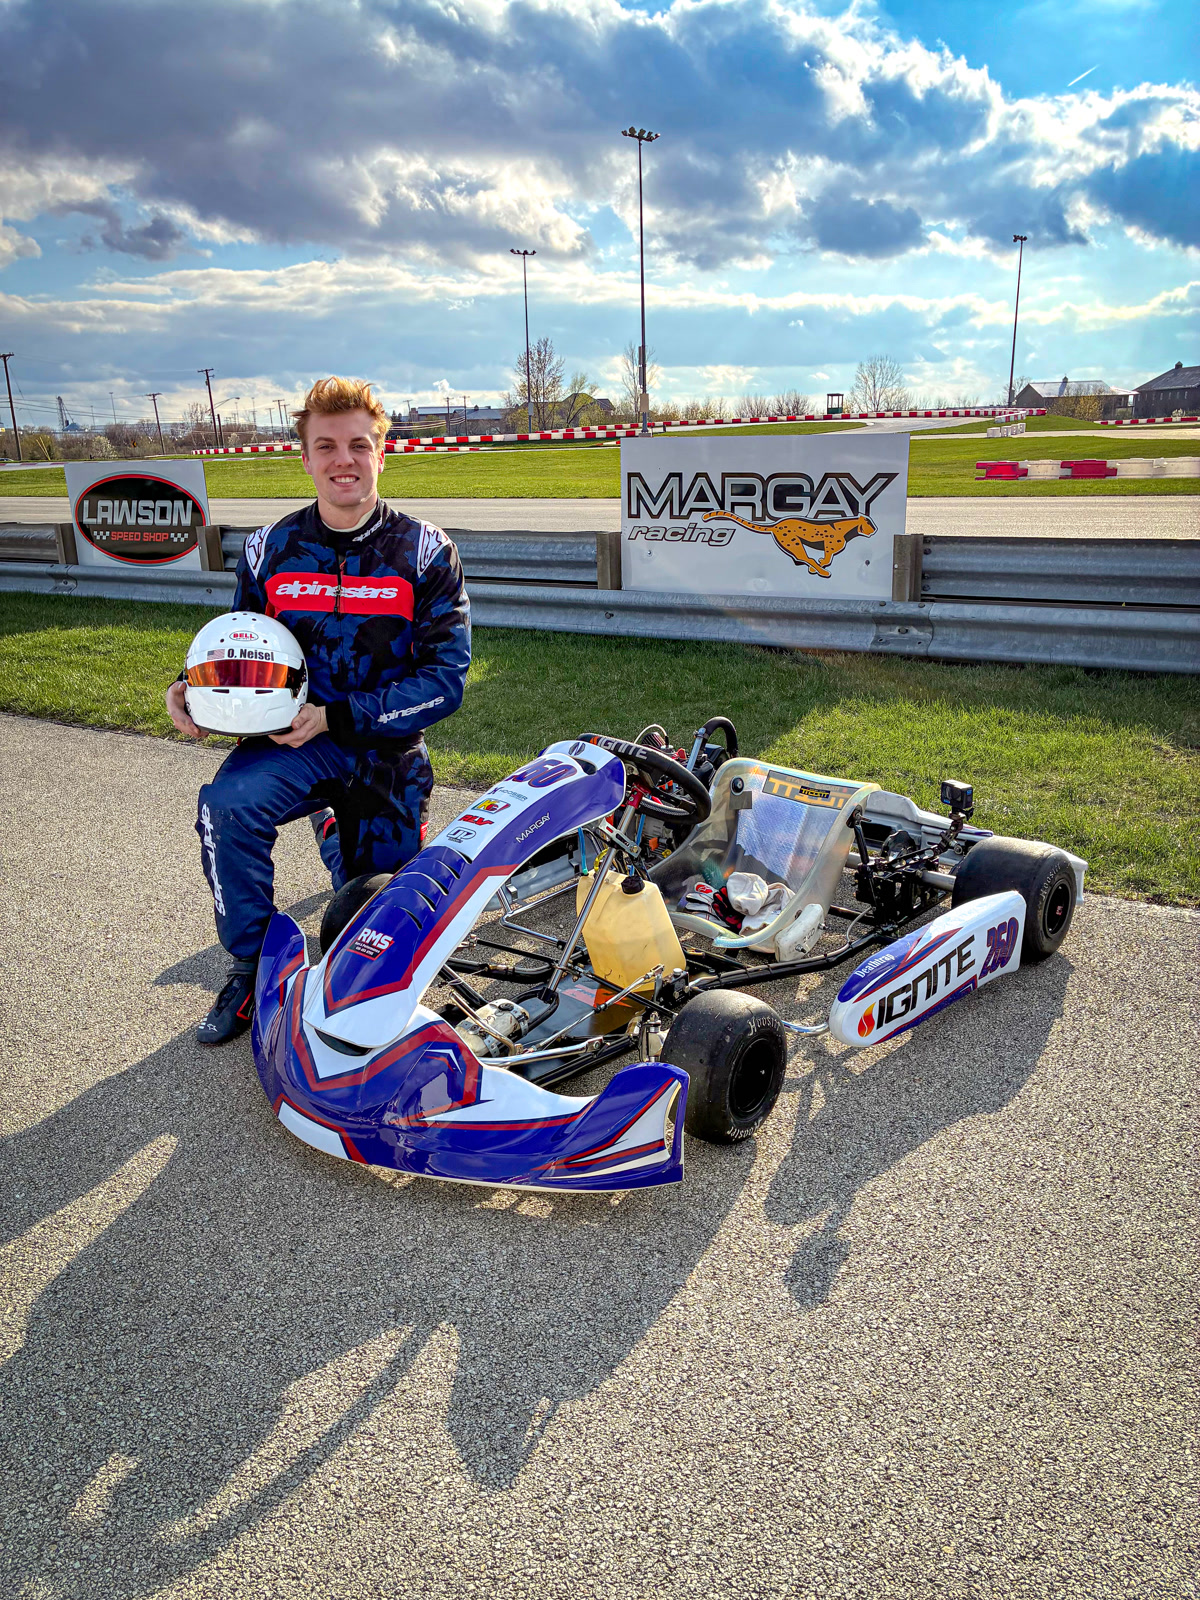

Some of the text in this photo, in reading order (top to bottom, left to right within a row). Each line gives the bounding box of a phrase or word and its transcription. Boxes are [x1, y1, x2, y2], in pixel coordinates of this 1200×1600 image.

[627, 472, 900, 522] MARGAY
[82, 499, 193, 527] LAWSON
[111, 531, 169, 543] SPEED SHOP
[628, 522, 737, 547] racing
[275, 580, 399, 599] alpinestars
[227, 648, 275, 662] O. Neisel
[597, 736, 648, 760] IGNITE
[515, 812, 551, 844] MARGAY
[357, 927, 394, 950] RMS
[854, 953, 895, 978] Deathtrap
[876, 935, 976, 1030] IGNITE
